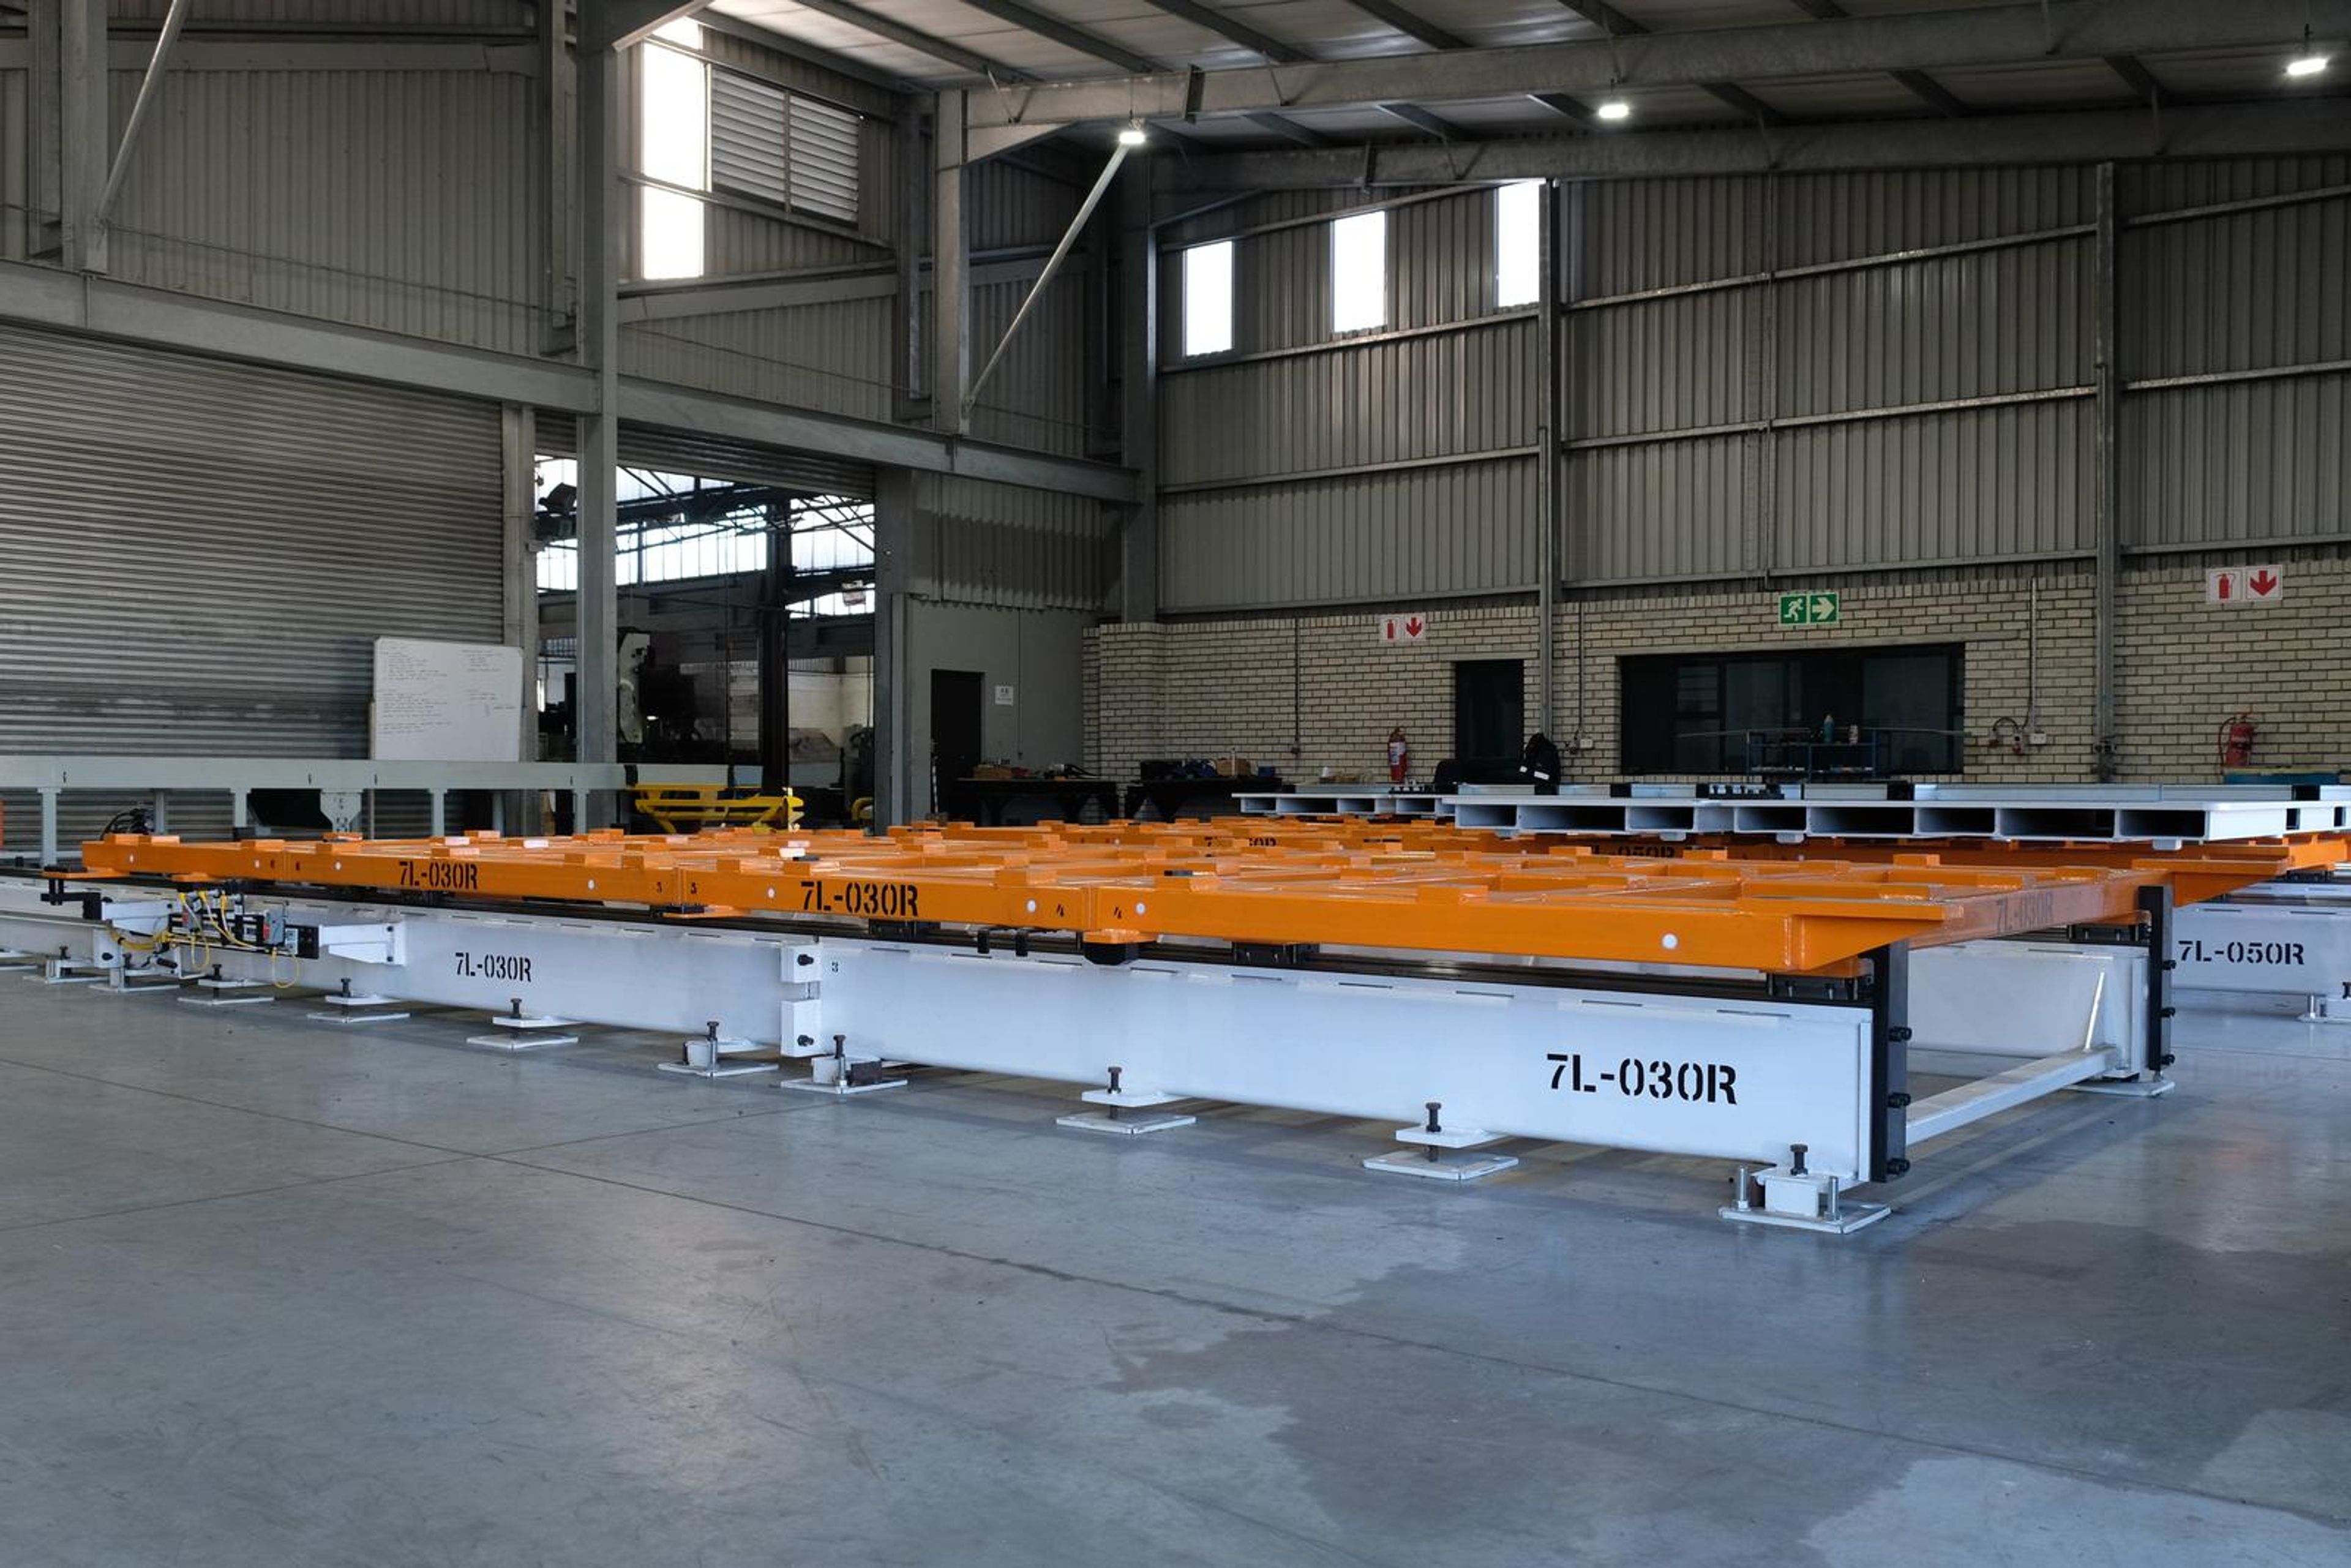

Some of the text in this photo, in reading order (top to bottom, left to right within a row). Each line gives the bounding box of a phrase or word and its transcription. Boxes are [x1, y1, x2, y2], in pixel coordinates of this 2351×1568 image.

[399, 861, 478, 890] 7L-030R
[801, 881, 919, 917] 7L-030R
[456, 951, 531, 982] 7L-030R
[831, 961, 839, 972] 3
[2178, 940, 2305, 966] 7L-050R
[1547, 1053, 1738, 1105] 7L-030R
